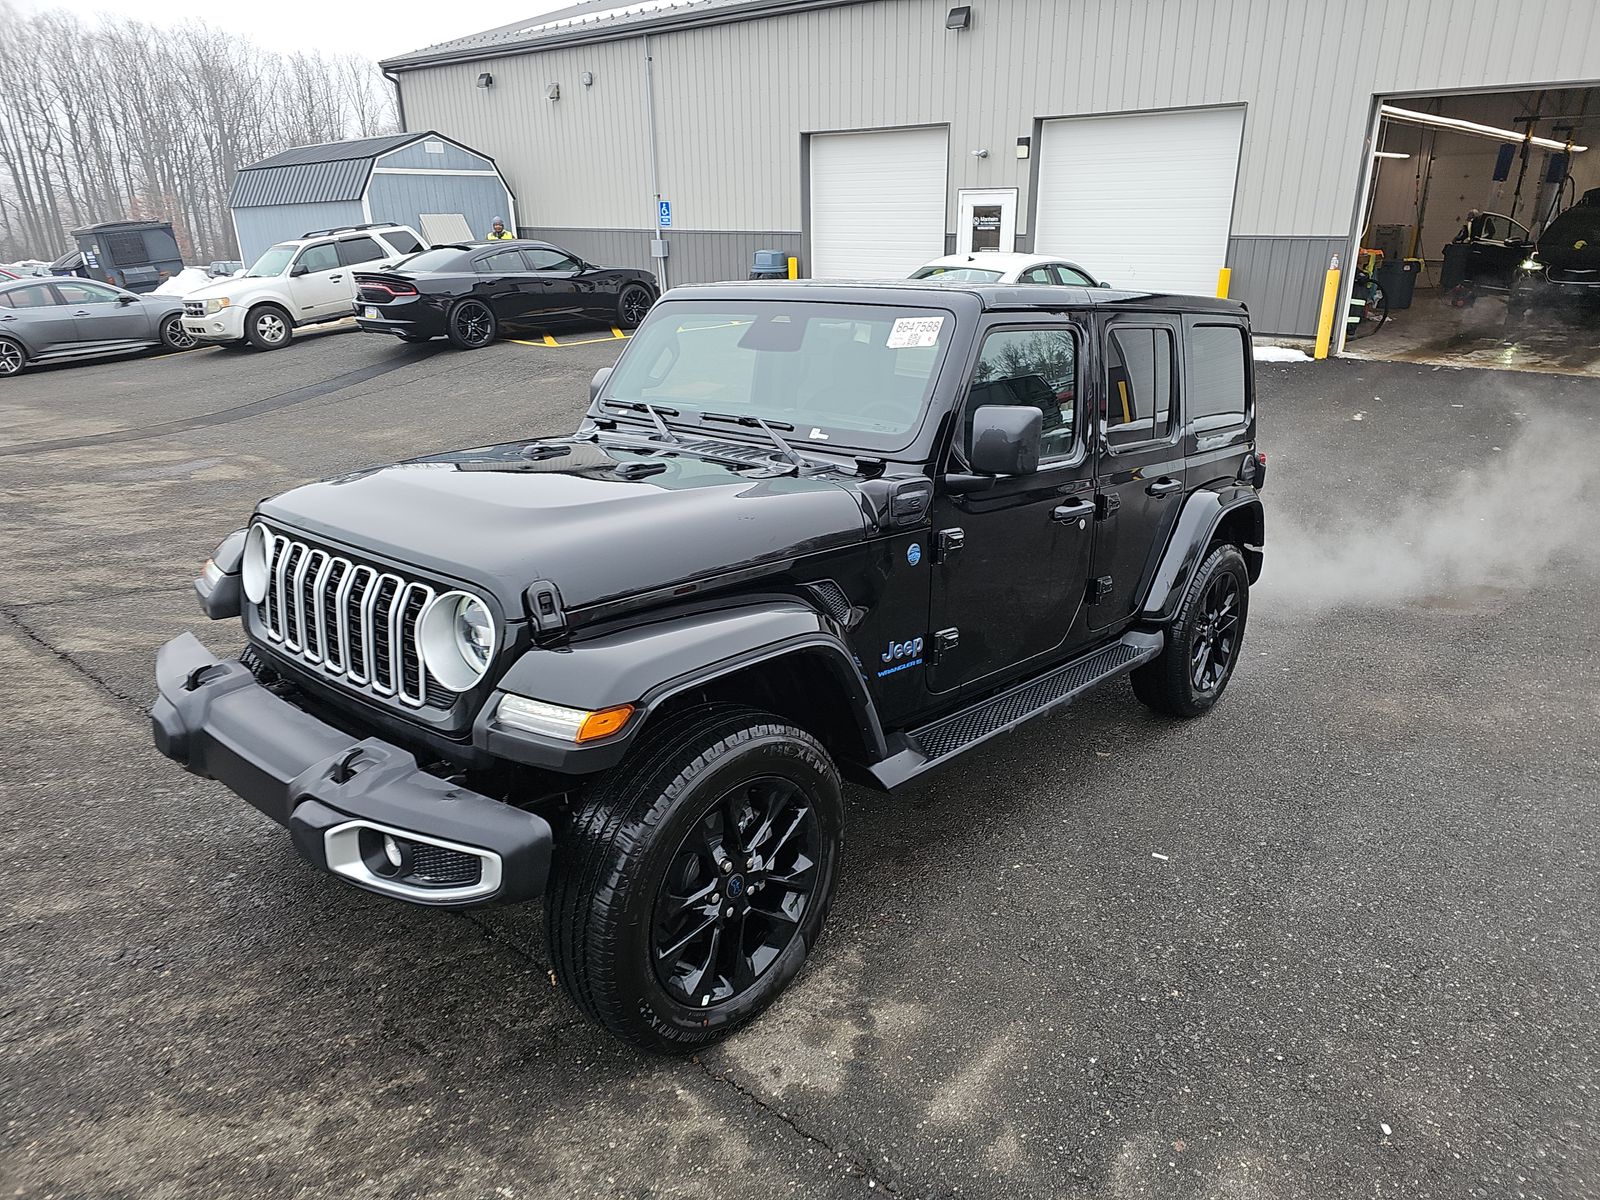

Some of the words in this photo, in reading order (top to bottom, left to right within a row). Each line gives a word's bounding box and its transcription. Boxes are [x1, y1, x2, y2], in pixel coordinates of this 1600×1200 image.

[896, 320, 940, 333] 8647588
[881, 637, 924, 663] Jeep
[877, 660, 916, 678] WRANGLER
